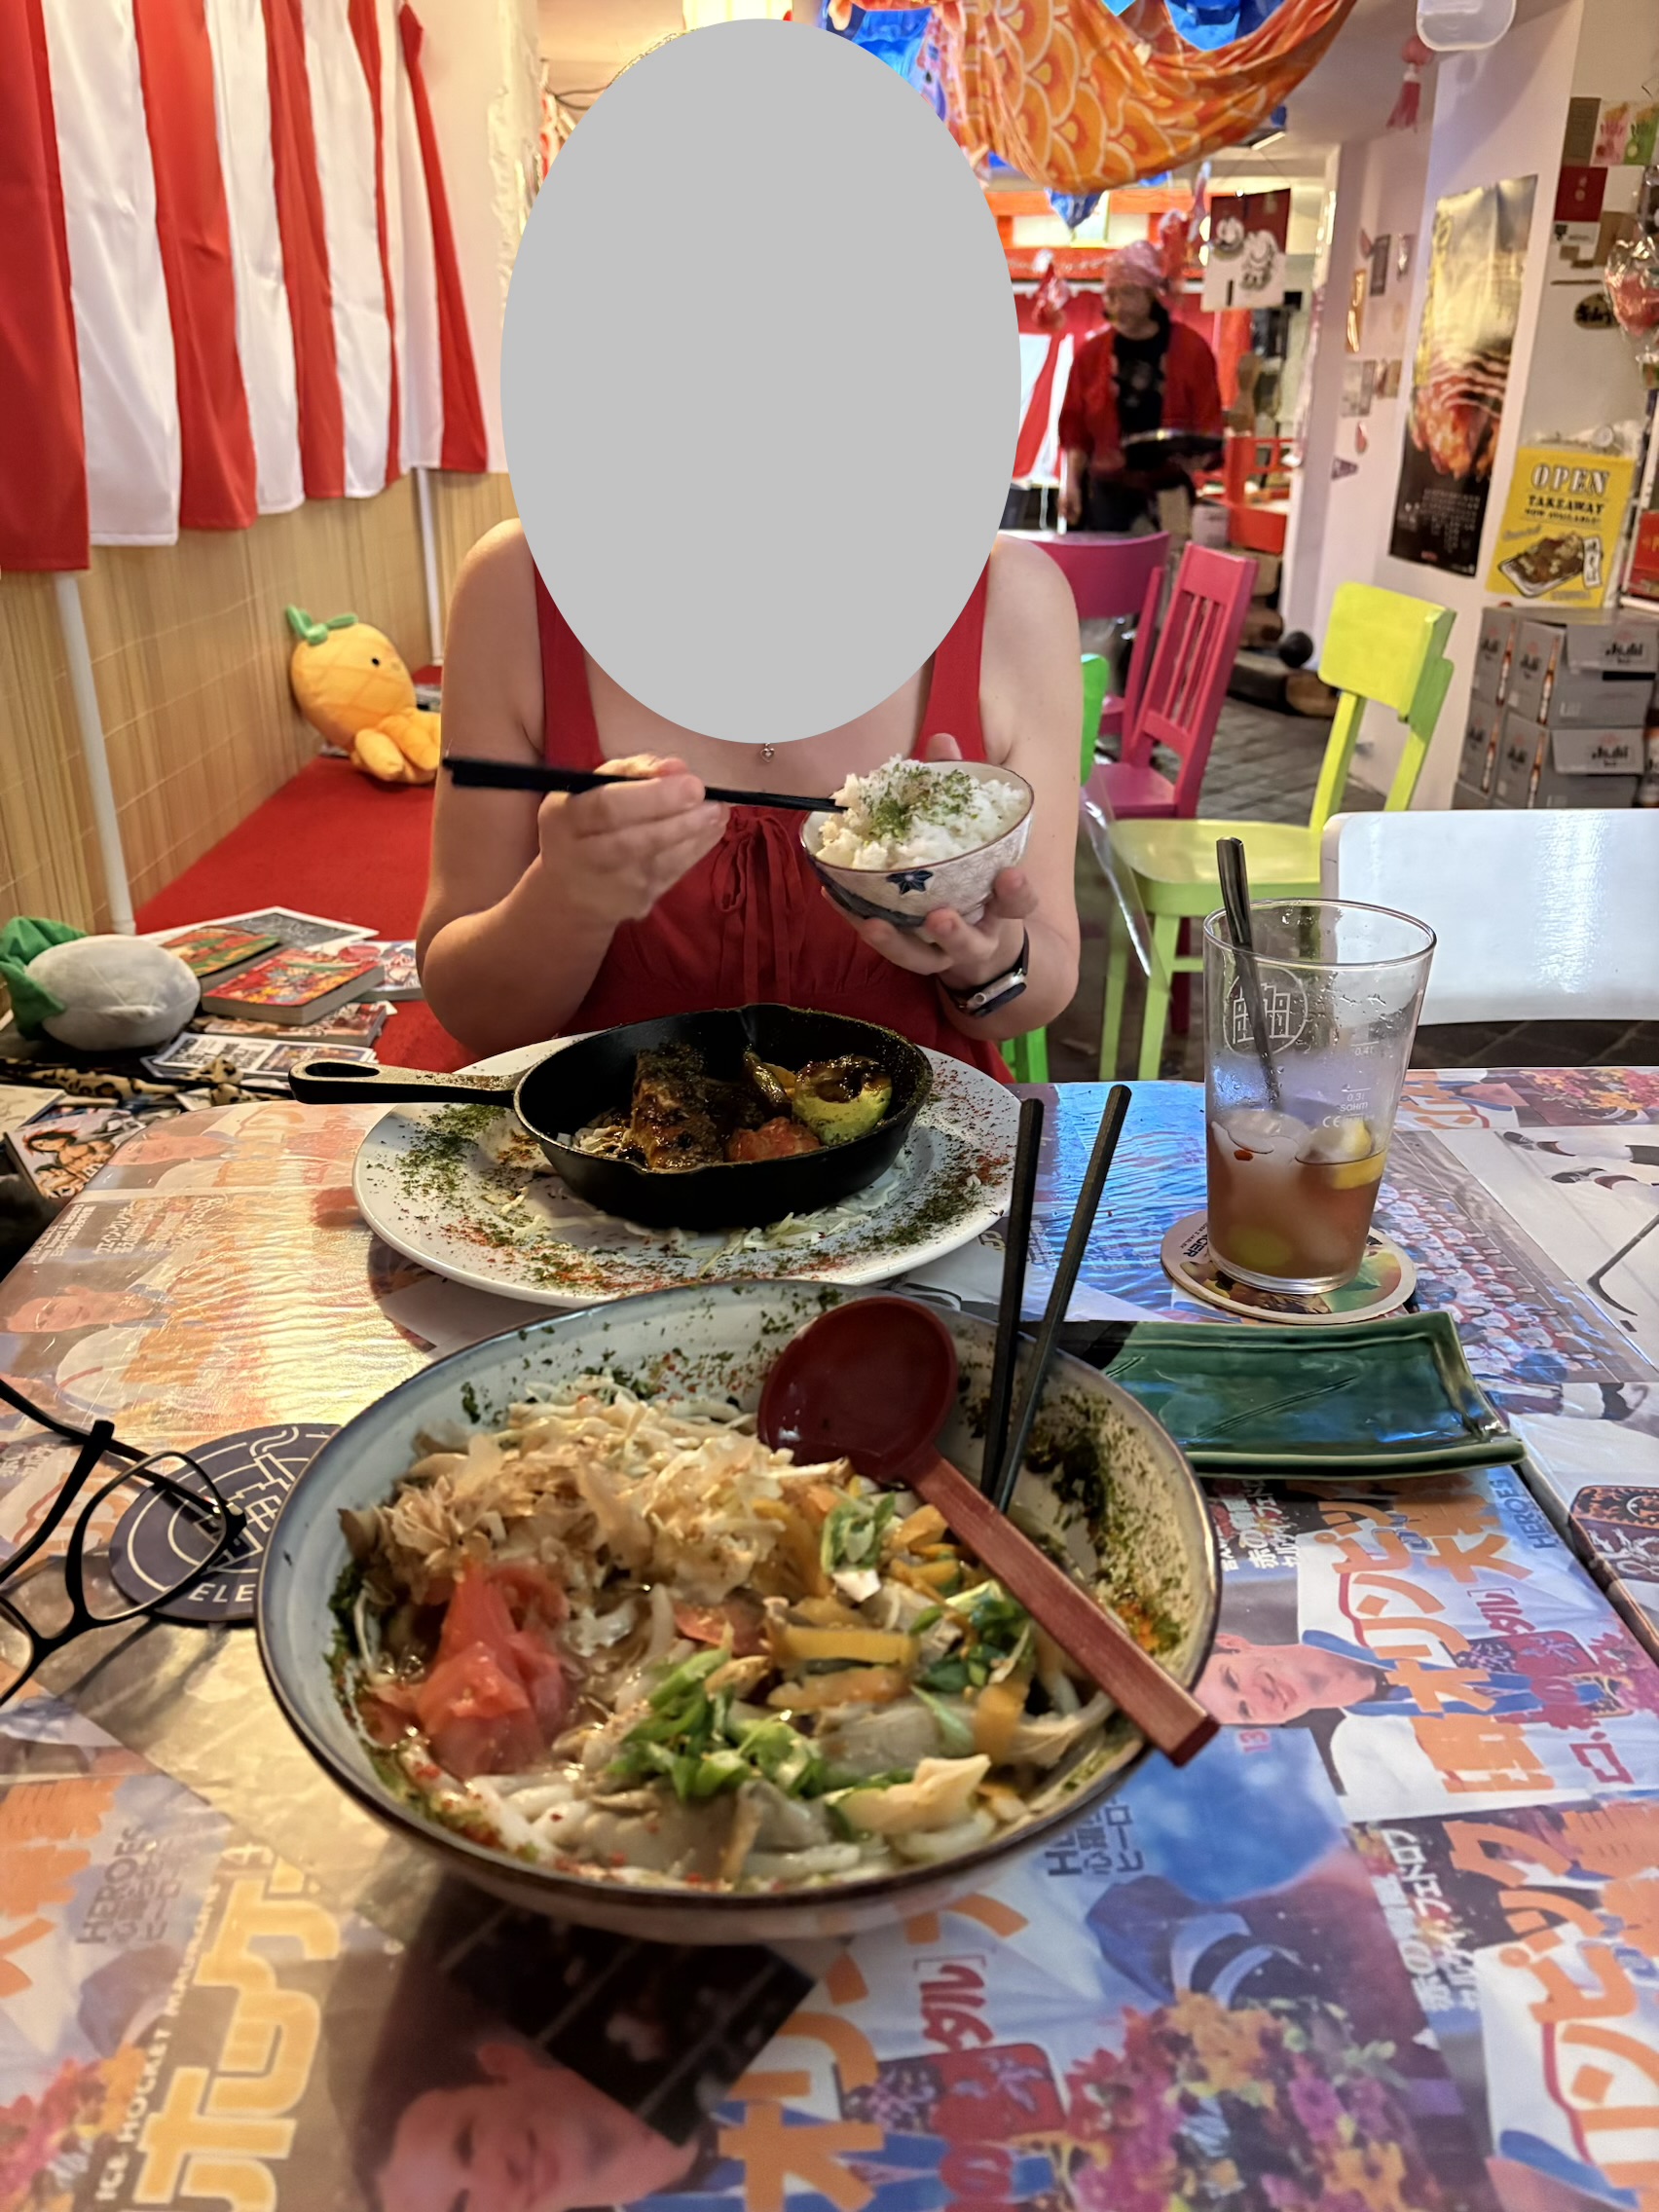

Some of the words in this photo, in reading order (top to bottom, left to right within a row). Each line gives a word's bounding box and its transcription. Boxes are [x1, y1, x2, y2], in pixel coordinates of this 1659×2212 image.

[1530, 463, 1610, 498] OPEN
[1529, 495, 1604, 515] TAKEAWAY
[1489, 1479, 1557, 1549] HEROES
[189, 1582, 257, 1604] ELE
[76, 1824, 149, 1944] HEROES
[95, 2153, 130, 2201] ICE
